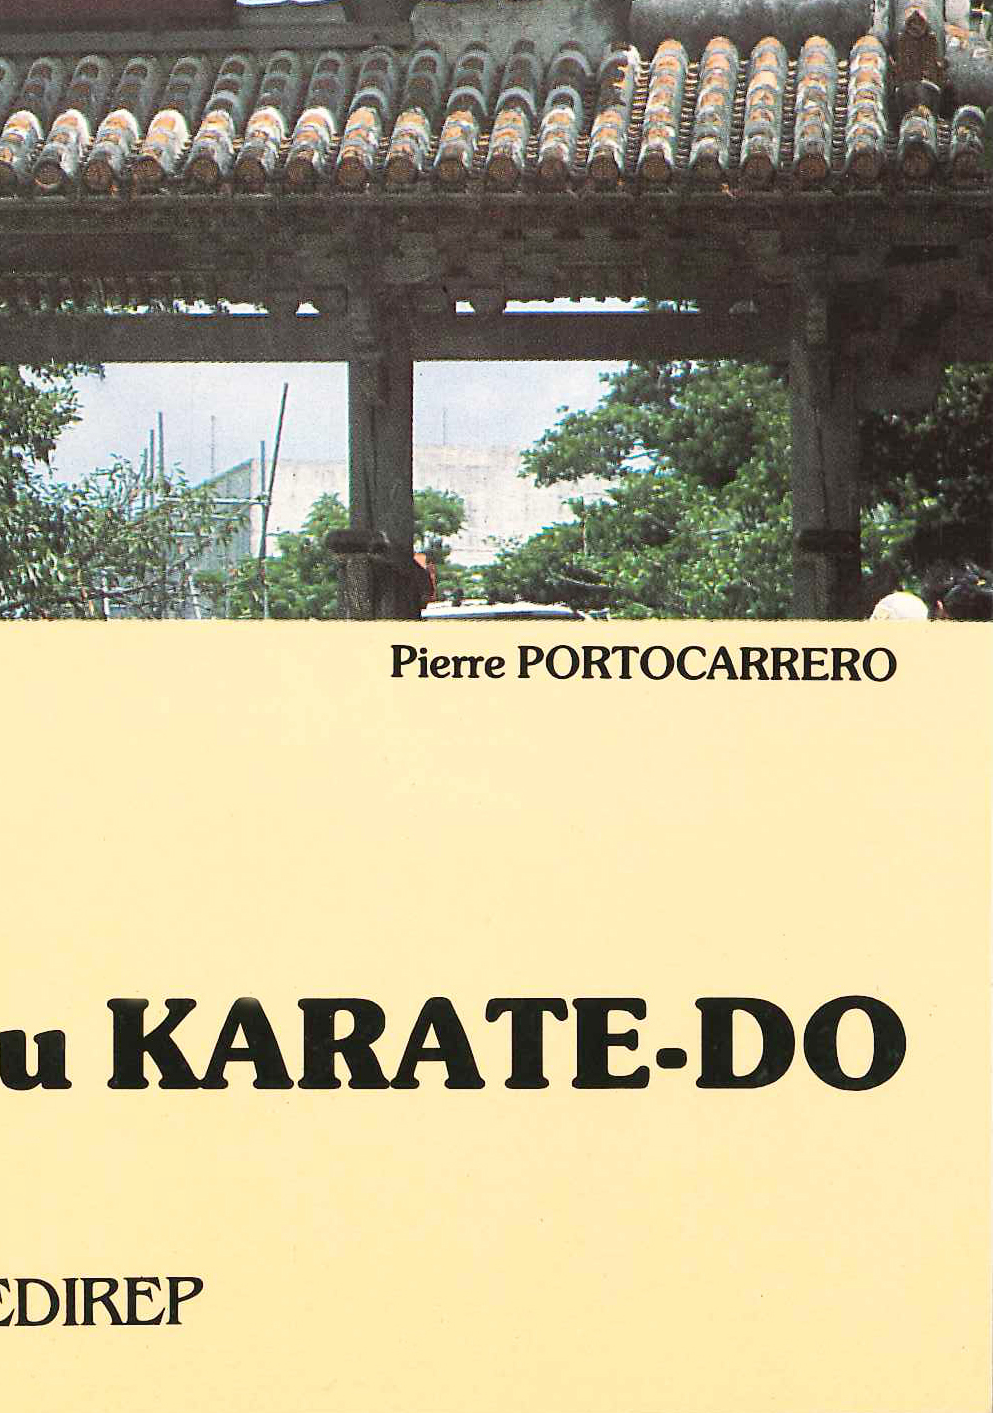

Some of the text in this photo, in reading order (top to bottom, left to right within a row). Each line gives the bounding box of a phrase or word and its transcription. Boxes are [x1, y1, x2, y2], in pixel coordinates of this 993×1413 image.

[391, 645, 897, 682] Pierre PORTOCARRERO
[107, 996, 906, 1091] KARATE-DO
